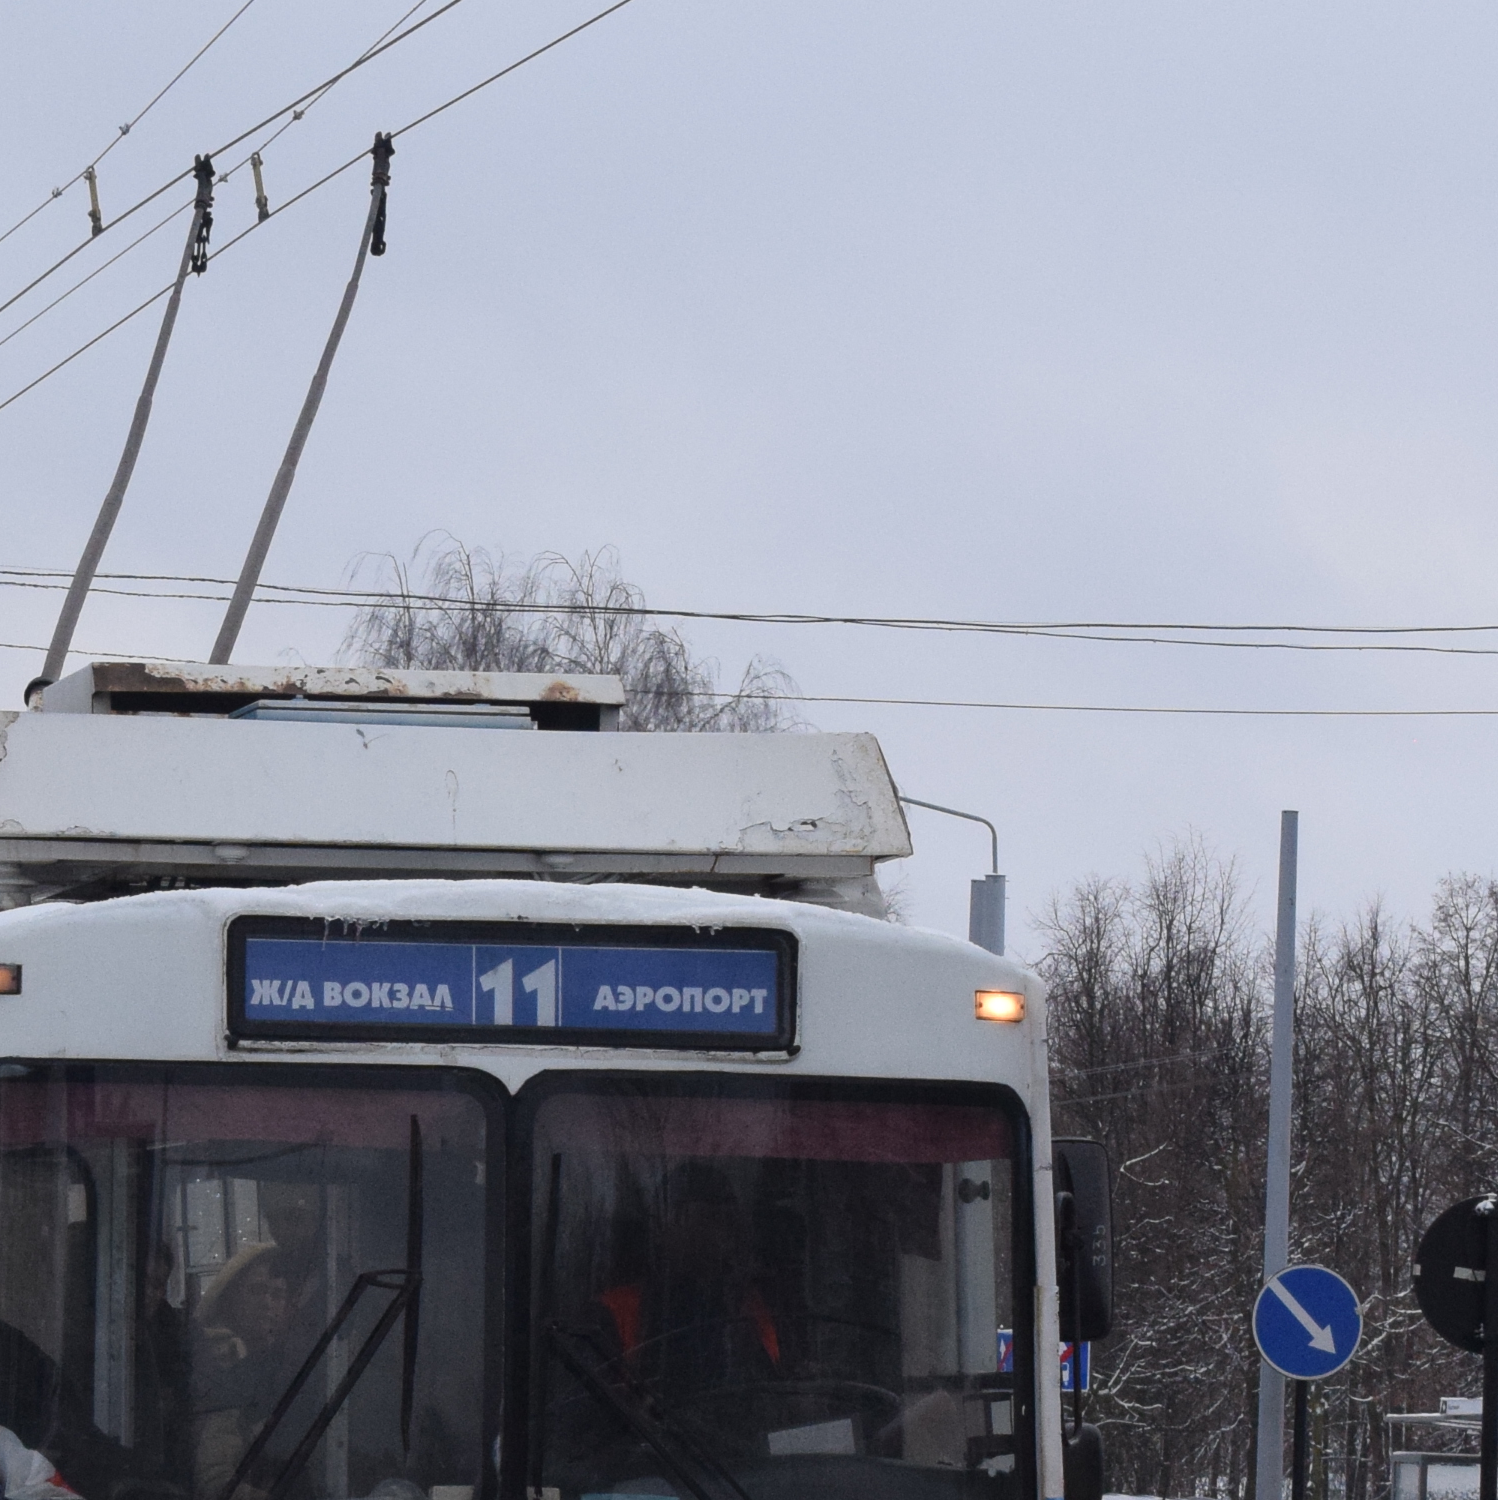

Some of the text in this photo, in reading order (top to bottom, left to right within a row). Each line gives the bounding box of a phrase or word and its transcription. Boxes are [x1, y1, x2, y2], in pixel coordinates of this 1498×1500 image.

[250, 958, 769, 1028] Ж/Д ВОКЗАЛ 11 АЭРОПОРТ
